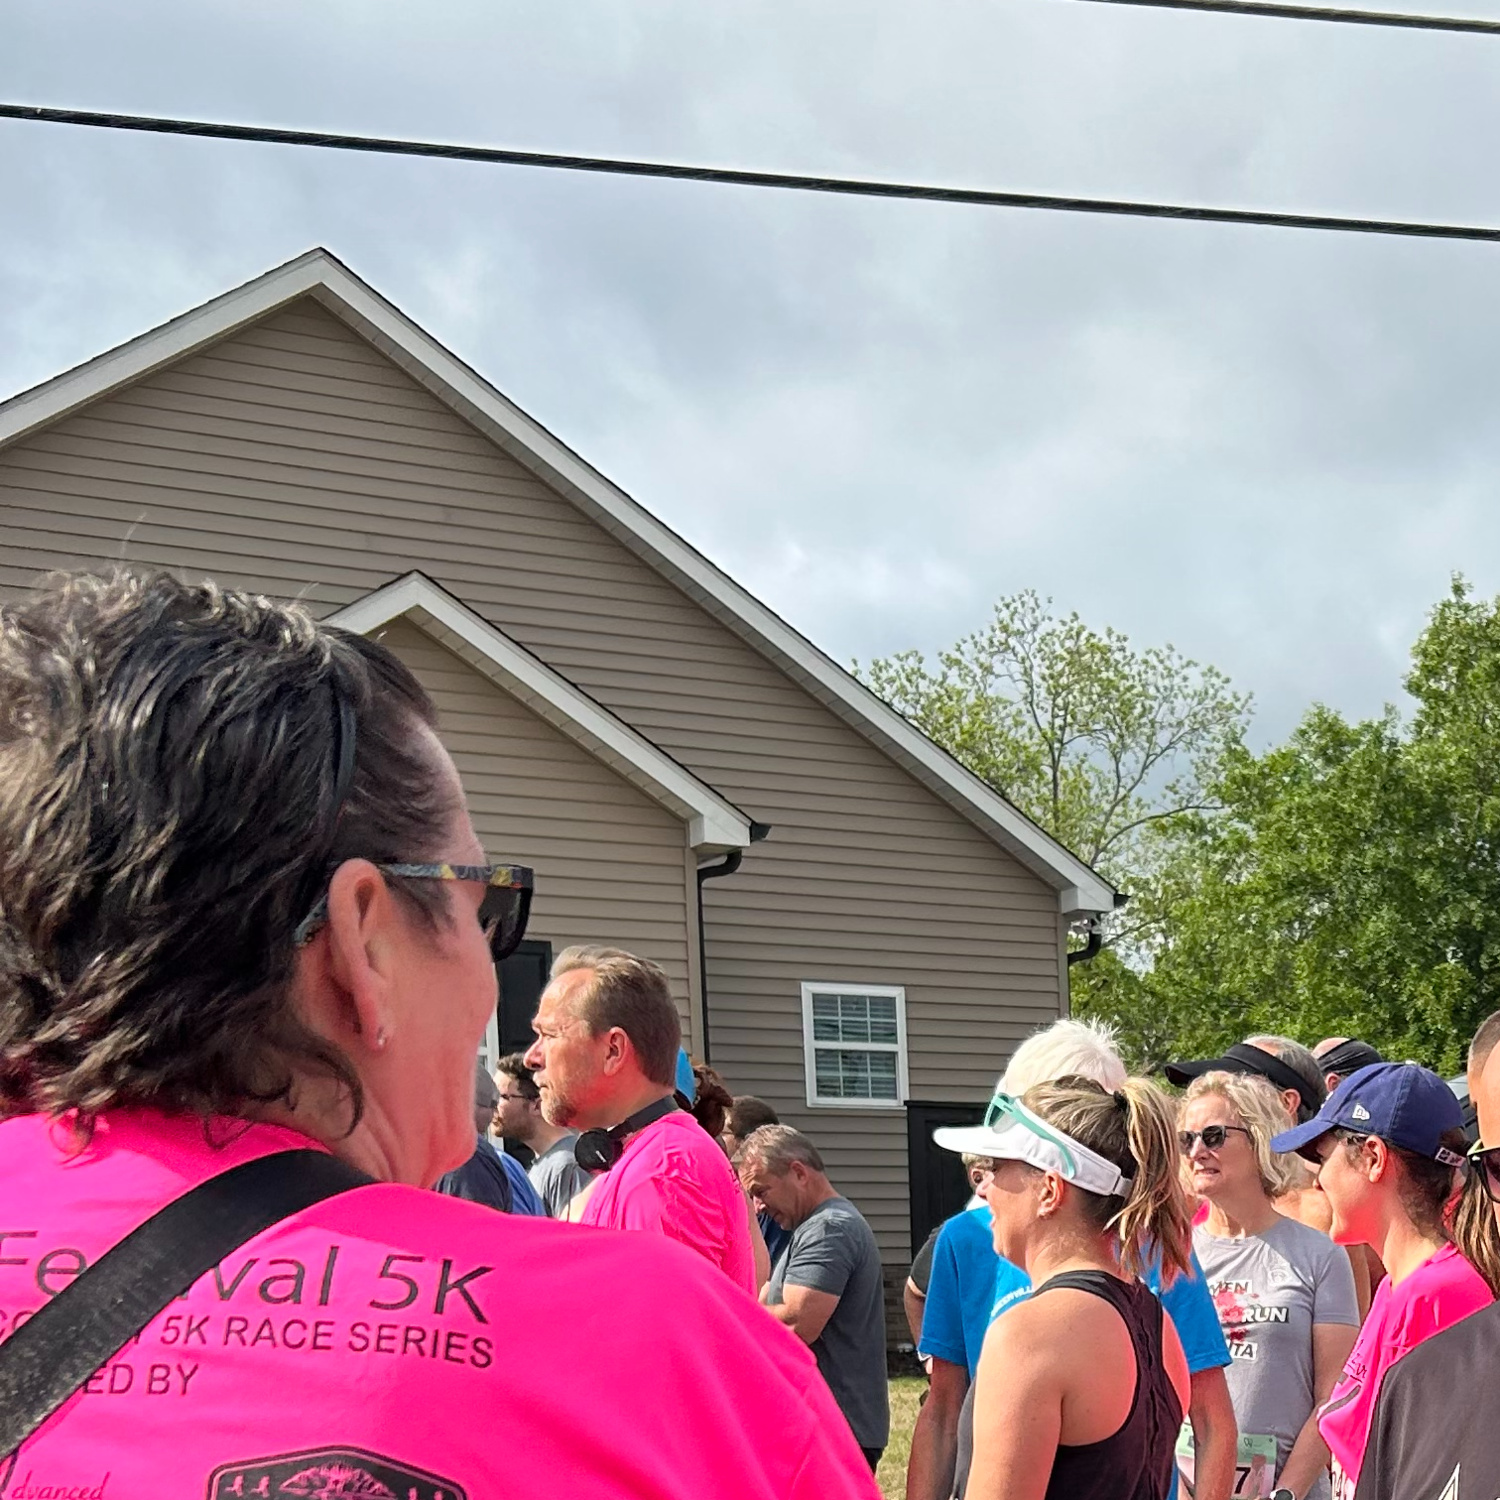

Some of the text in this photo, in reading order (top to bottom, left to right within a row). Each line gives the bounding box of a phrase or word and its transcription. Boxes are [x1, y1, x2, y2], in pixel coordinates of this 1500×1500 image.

[0, 1231, 496, 1324] Feval 5K
[1242, 1306, 1288, 1322] RUN
[160, 1315, 494, 1370] 5K RACE SERIES
[147, 1363, 199, 1396] BY
